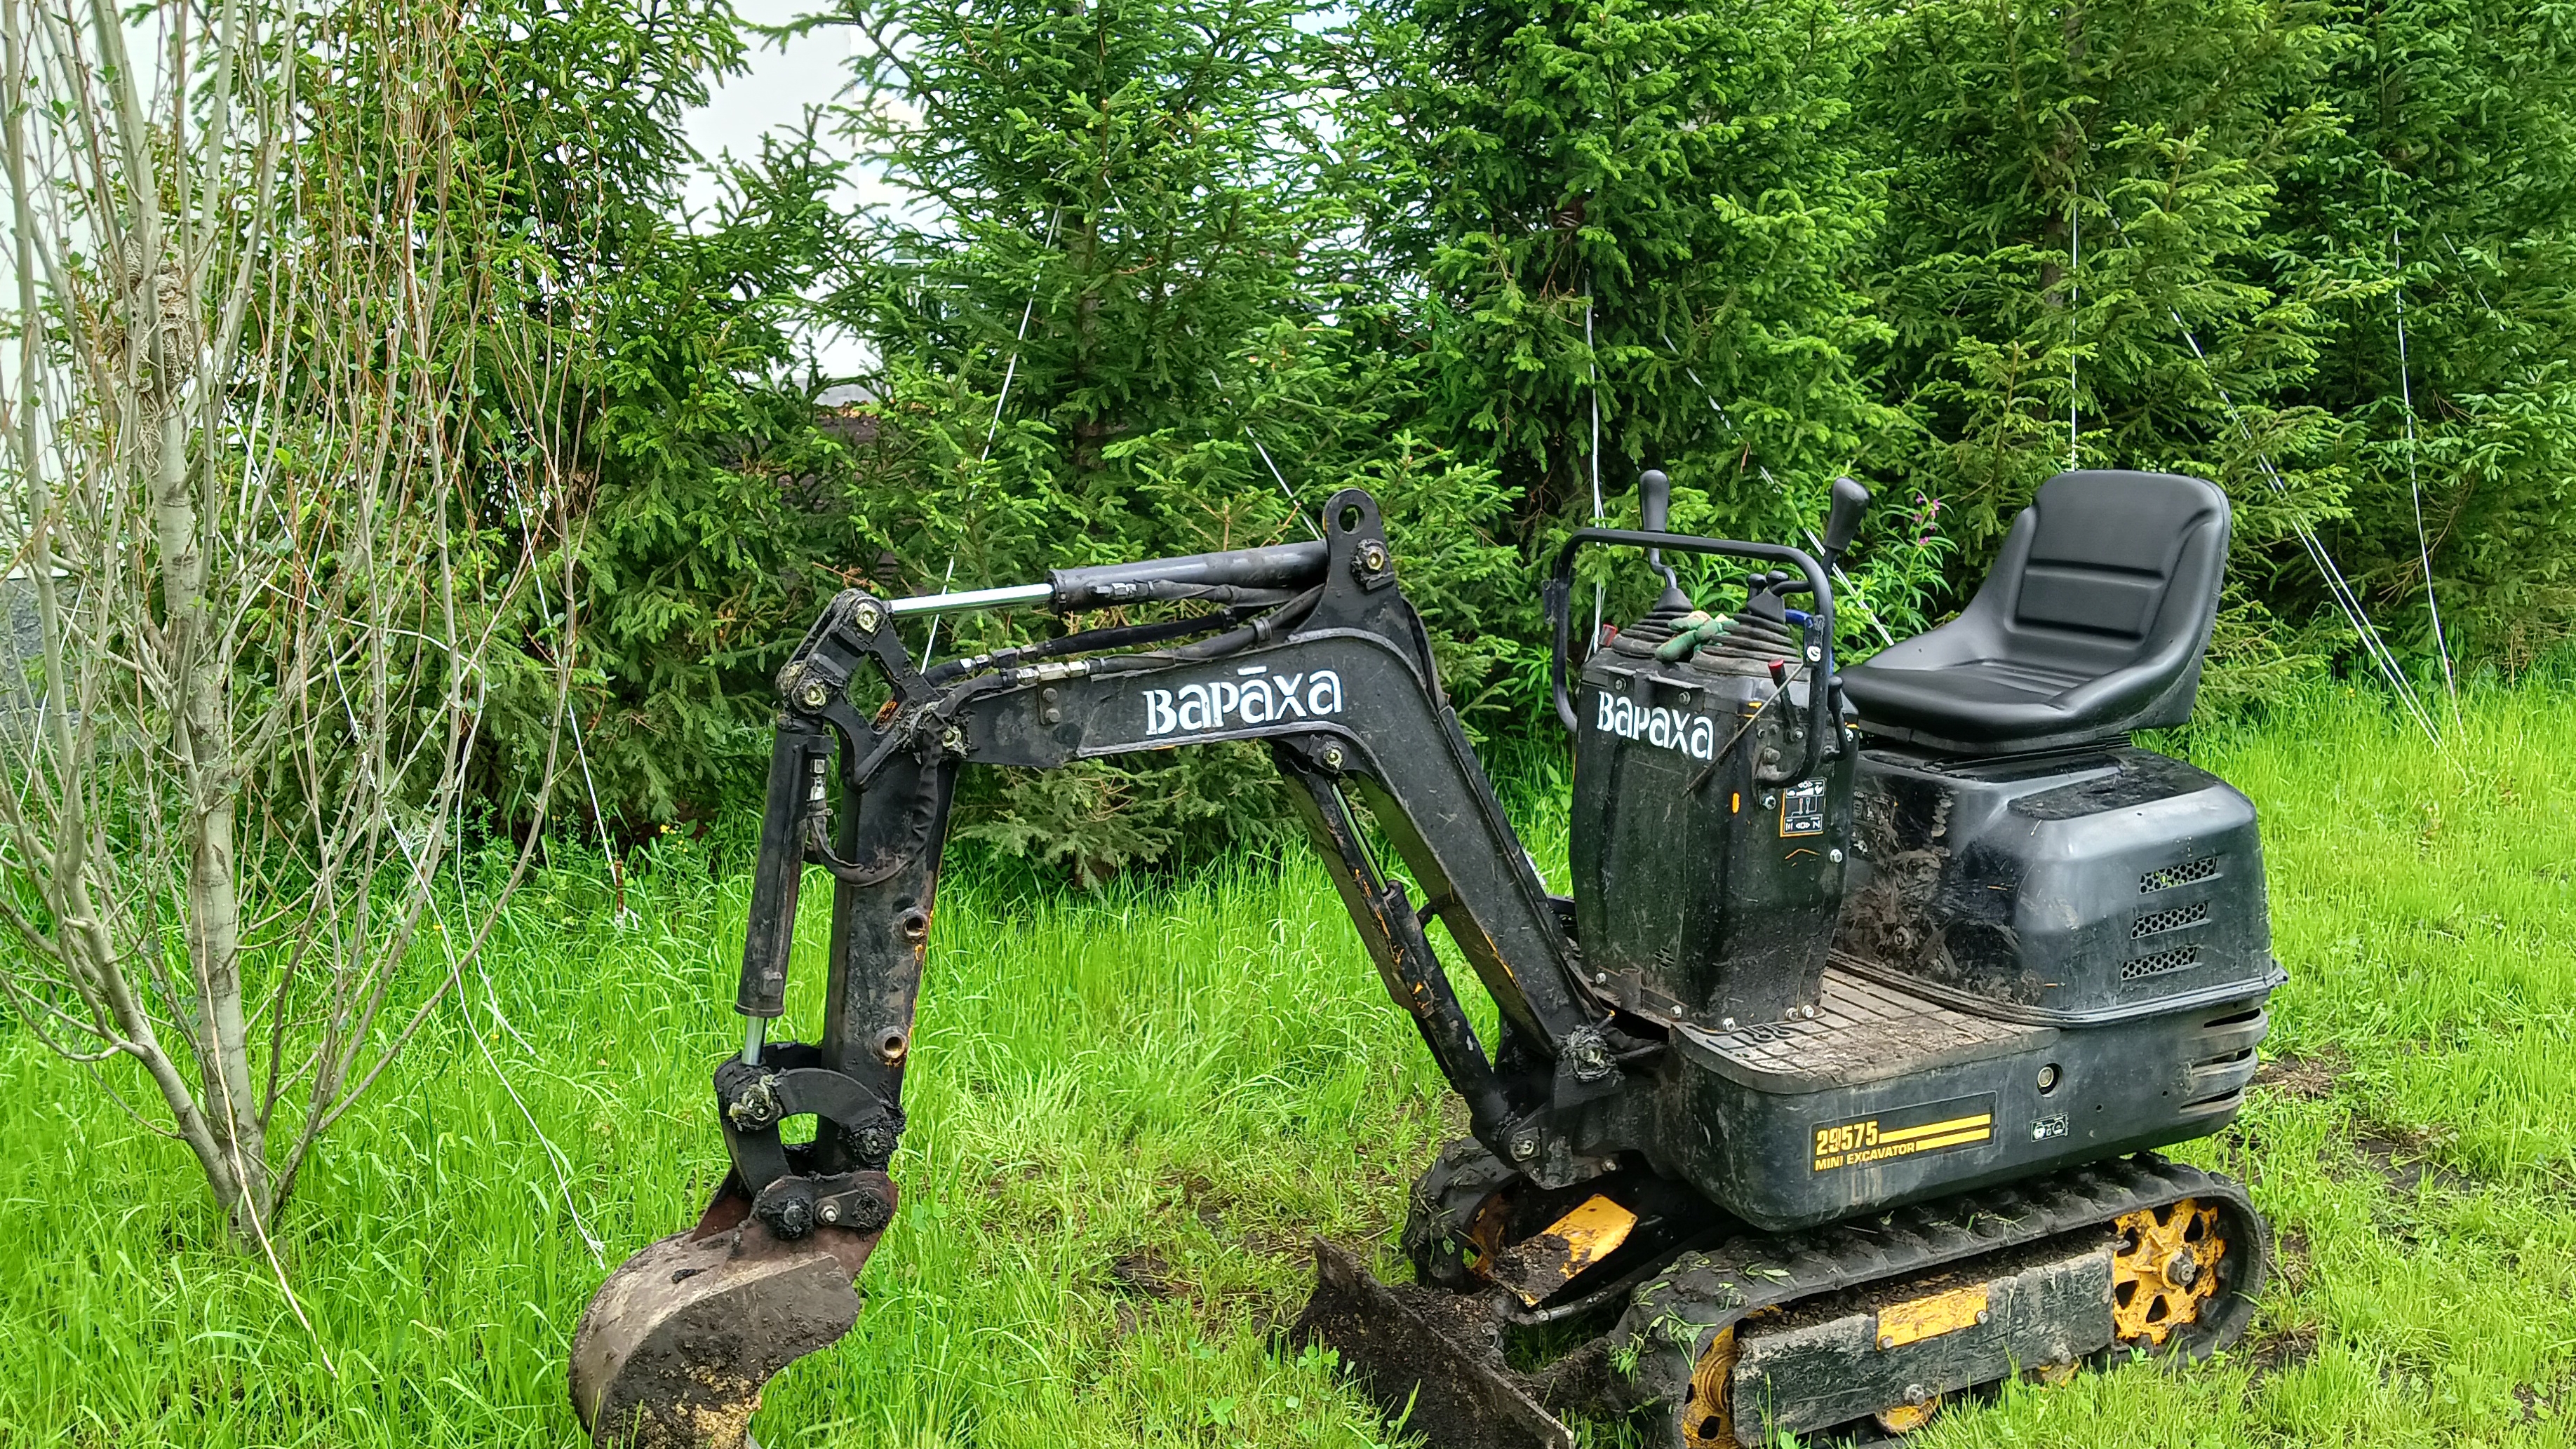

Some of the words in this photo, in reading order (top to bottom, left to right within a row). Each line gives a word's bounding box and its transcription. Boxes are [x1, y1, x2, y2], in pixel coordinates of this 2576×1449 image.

[1816, 1121, 1878, 1156] 29575
[1815, 1154, 1844, 1171] MINI
[1846, 1142, 1915, 1165] EXCAVATOR
